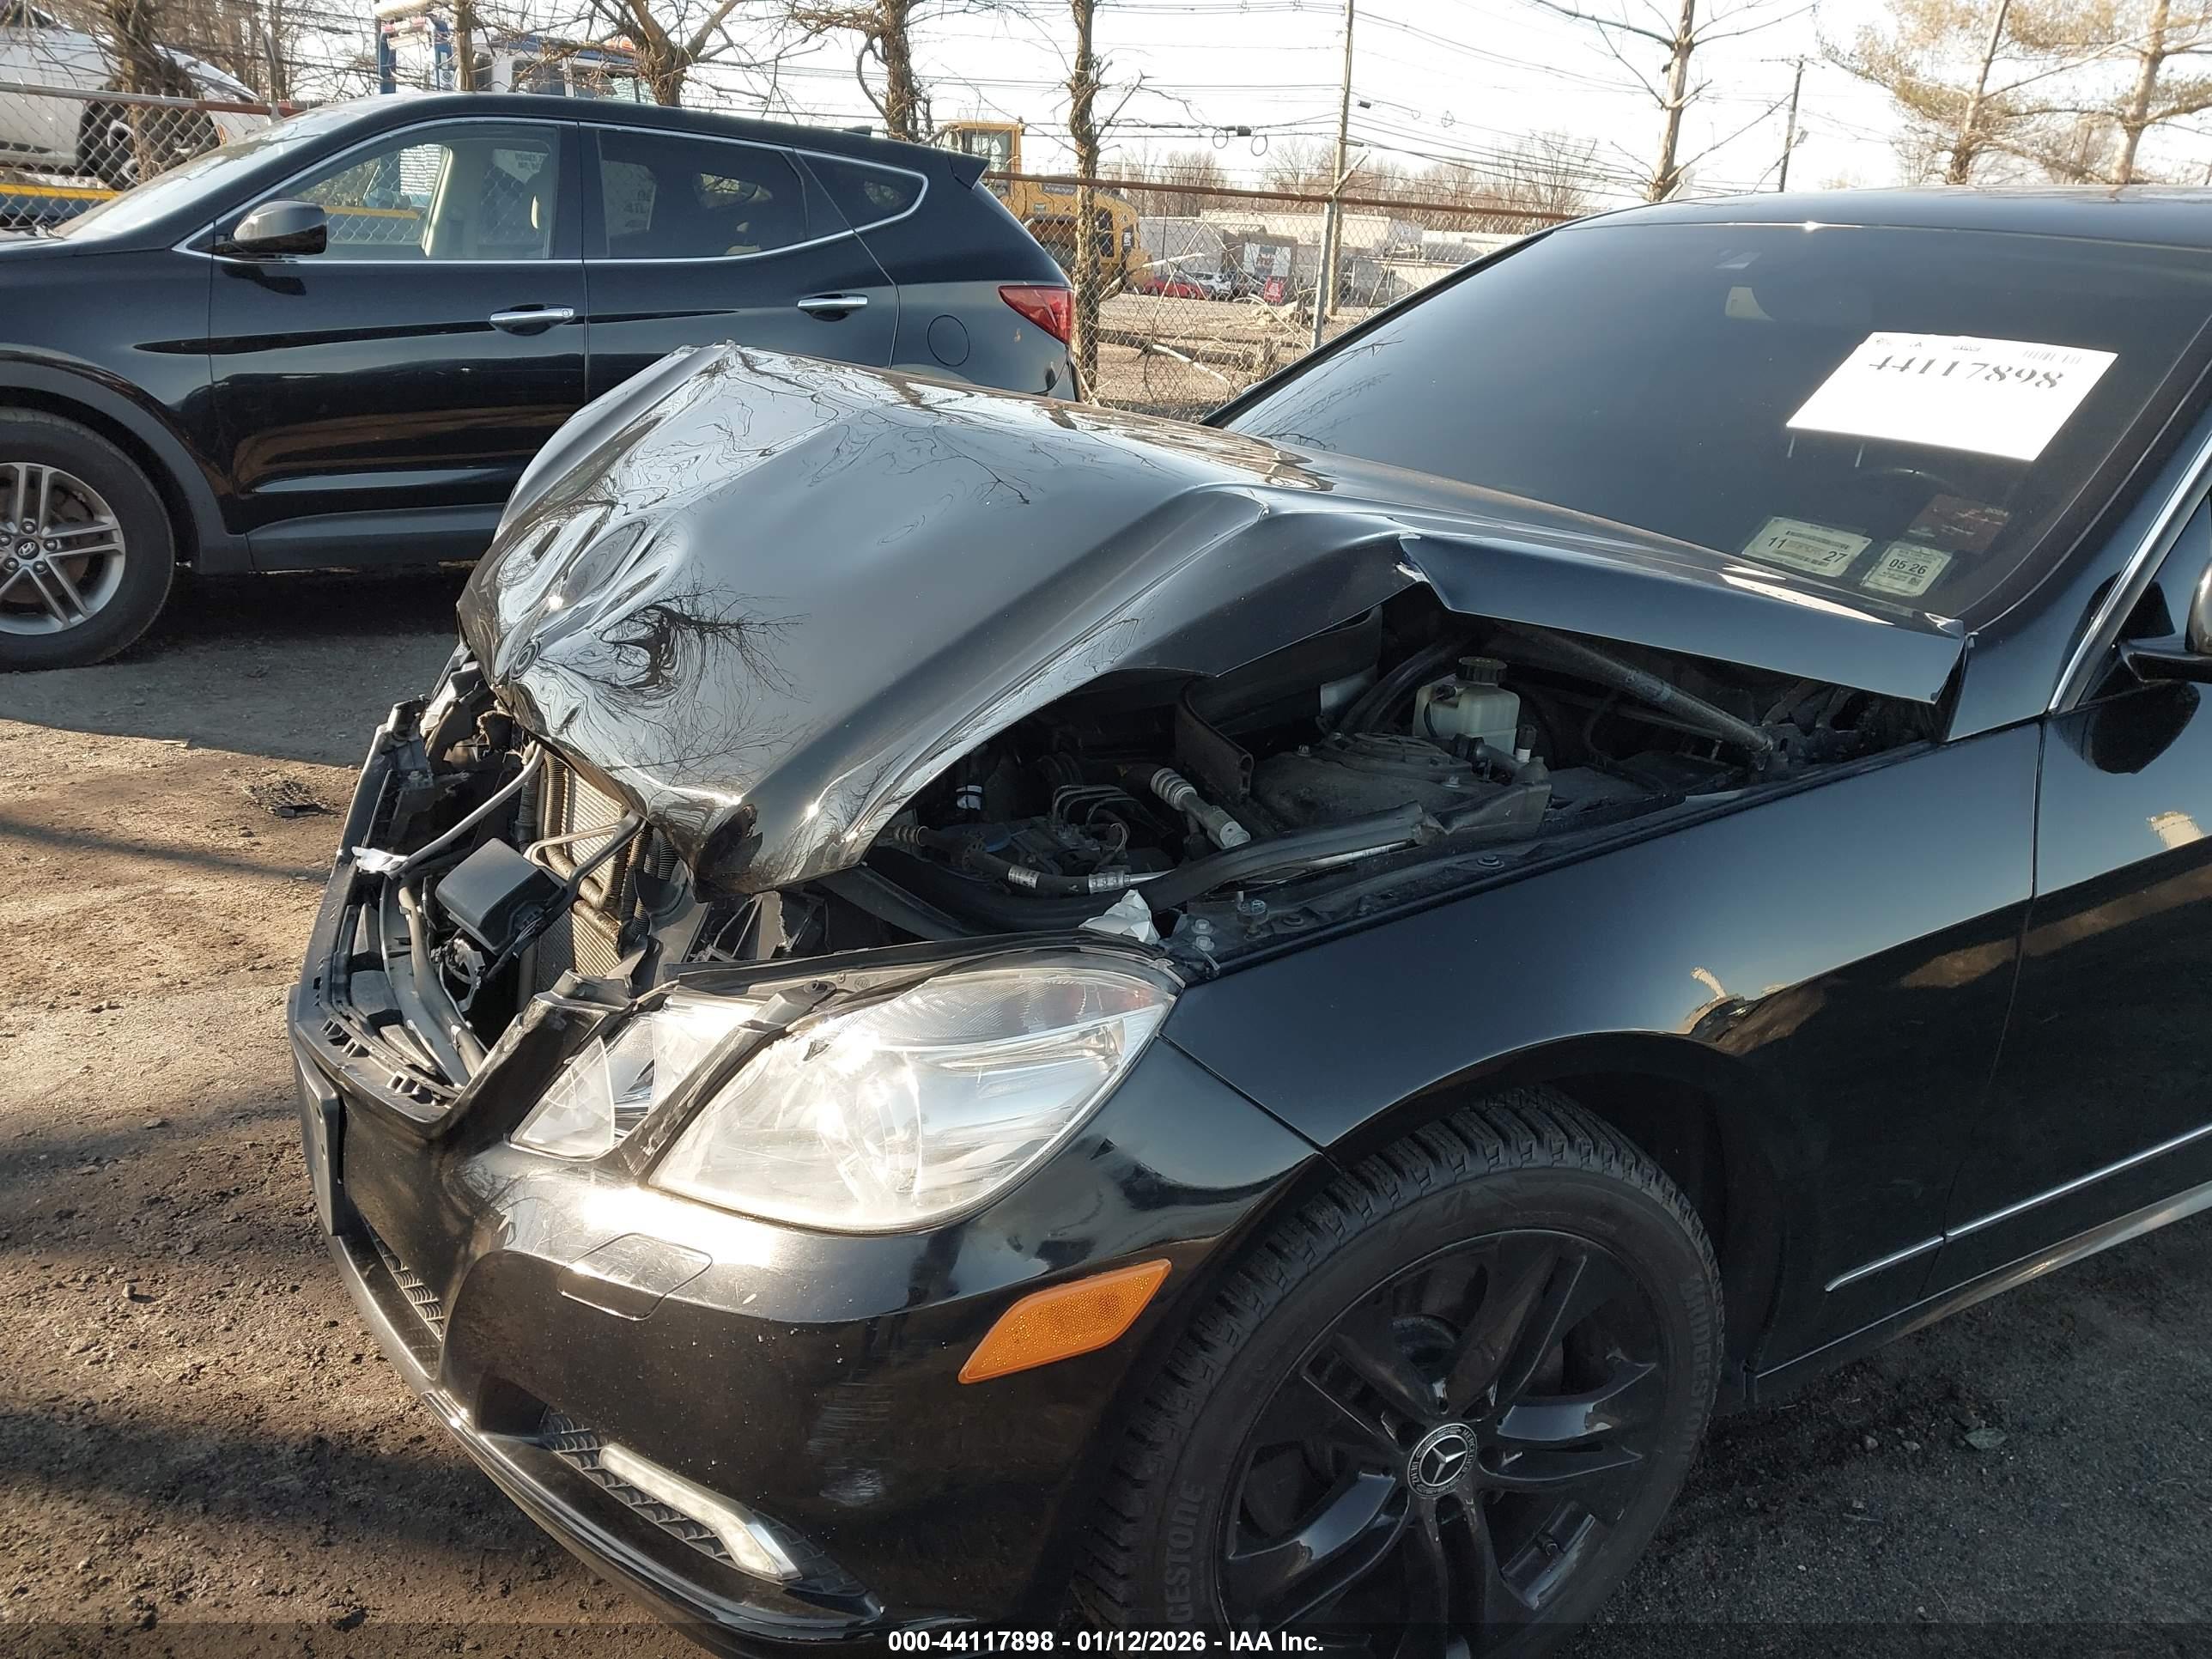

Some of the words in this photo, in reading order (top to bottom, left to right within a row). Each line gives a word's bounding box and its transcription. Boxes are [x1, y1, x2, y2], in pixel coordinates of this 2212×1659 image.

[1869, 356, 2063, 388] 44117898
[1768, 536, 1788, 549] 11
[1822, 550, 1848, 563] 27
[1889, 558, 1908, 569] 05
[1908, 562, 1929, 574] 26
